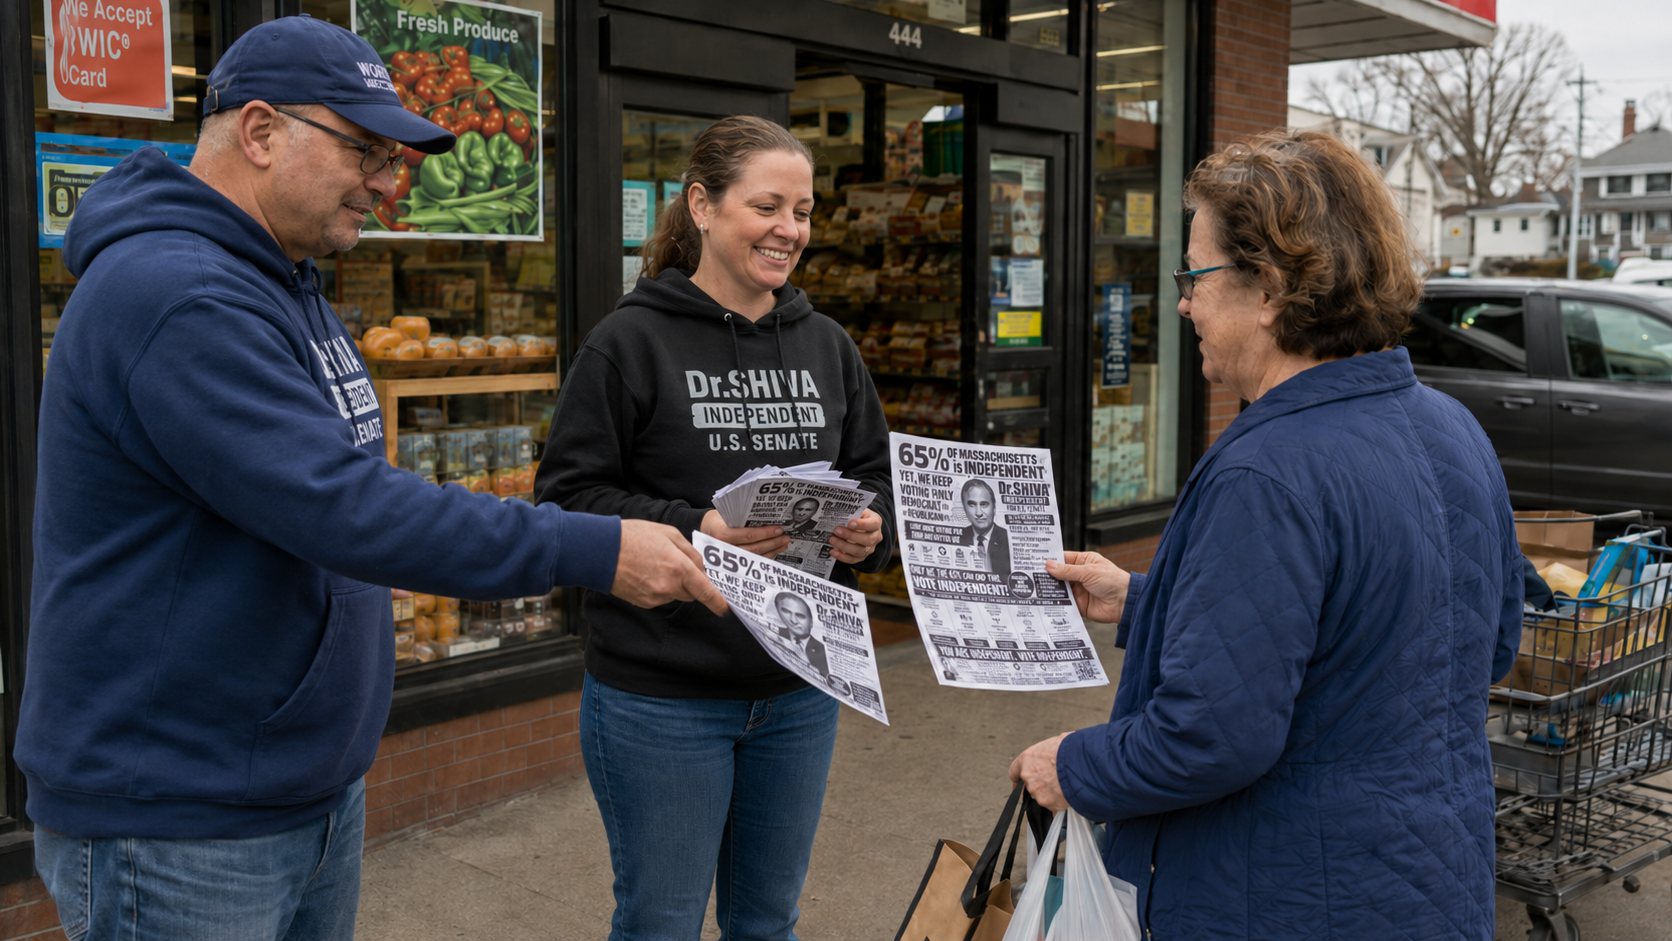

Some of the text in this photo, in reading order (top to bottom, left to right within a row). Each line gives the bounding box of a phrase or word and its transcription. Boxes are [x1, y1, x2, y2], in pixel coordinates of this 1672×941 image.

[64, 0, 153, 30] We Accept
[397, 10, 519, 44] Fresh Produce
[888, 22, 922, 49] 444
[69, 65, 107, 87] Card
[685, 369, 821, 399] Dr.SHIVA
[708, 432, 818, 451] U.S. SENATE
[898, 442, 1038, 472] 65% OF MASSACHUSETTS
[964, 461, 1045, 480] INDEPENDENT
[759, 482, 795, 495] 65%
[918, 472, 931, 486] WE
[932, 474, 953, 487] KEEP
[703, 545, 762, 580] 65%
[759, 562, 771, 573] OF
[724, 573, 740, 588] WE
[764, 573, 775, 585] IS
[777, 575, 858, 614] INDEPENDENT
